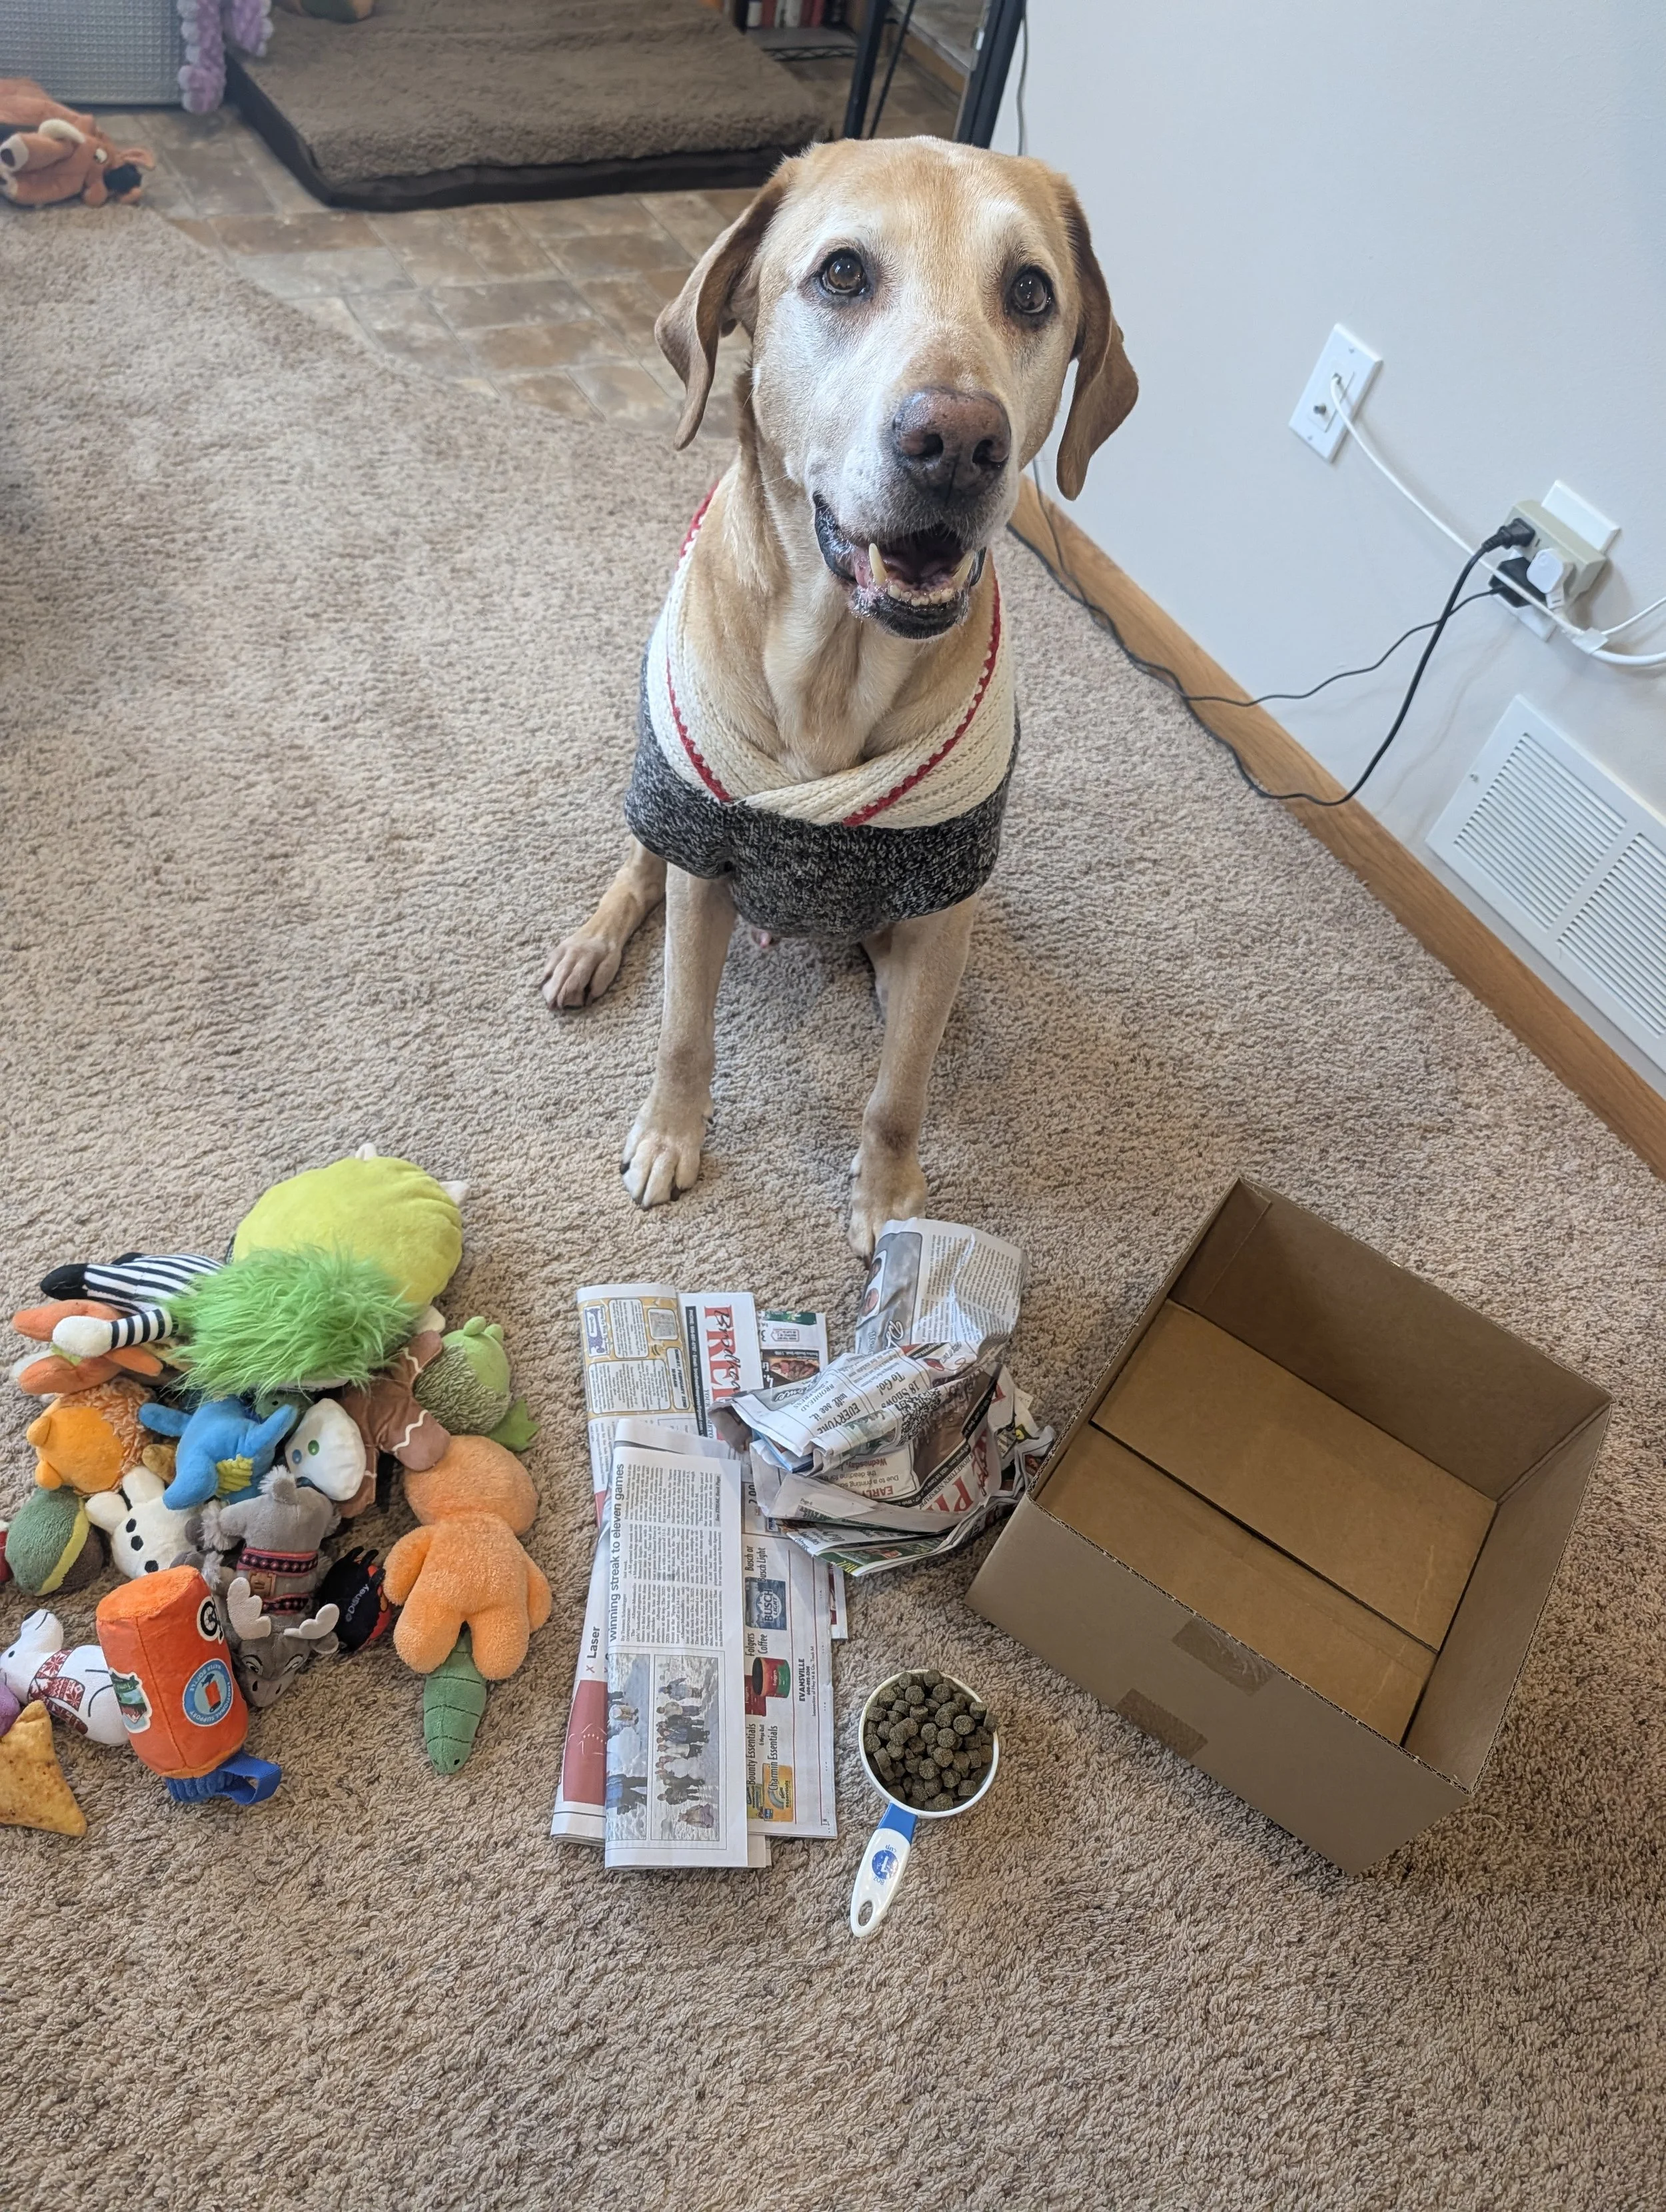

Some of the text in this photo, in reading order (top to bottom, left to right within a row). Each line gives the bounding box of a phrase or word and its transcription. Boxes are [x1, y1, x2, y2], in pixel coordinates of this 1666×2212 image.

[676, 1369, 685, 1394] FEBRUARY
[876, 1372, 906, 1396] To Go!
[881, 1380, 920, 1408] 18 Snows
[800, 1383, 835, 1412] BRODHEAD
[808, 1392, 848, 1422] will see it.
[846, 1458, 887, 1470] Wednesday,
[849, 1478, 872, 1488] printing
[609, 1463, 624, 1642] winning streak to eleven games
[744, 1553, 754, 1571] Busch
[757, 1547, 768, 1582] Busch Light
[763, 1589, 774, 1622] BUSCH
[586, 1626, 600, 1658] Laser
[745, 1632, 755, 1656] Folgers
[758, 1634, 768, 1654] Coffee
[189, 1669, 207, 1692] BOTTLE
[190, 1710, 215, 1722] SUPPORT
[746, 1724, 756, 1758] Essentials
[767, 1726, 778, 1791] Charmin Essentials
[746, 1760, 758, 1786] Bounty
[885, 1844, 897, 1853] cup
